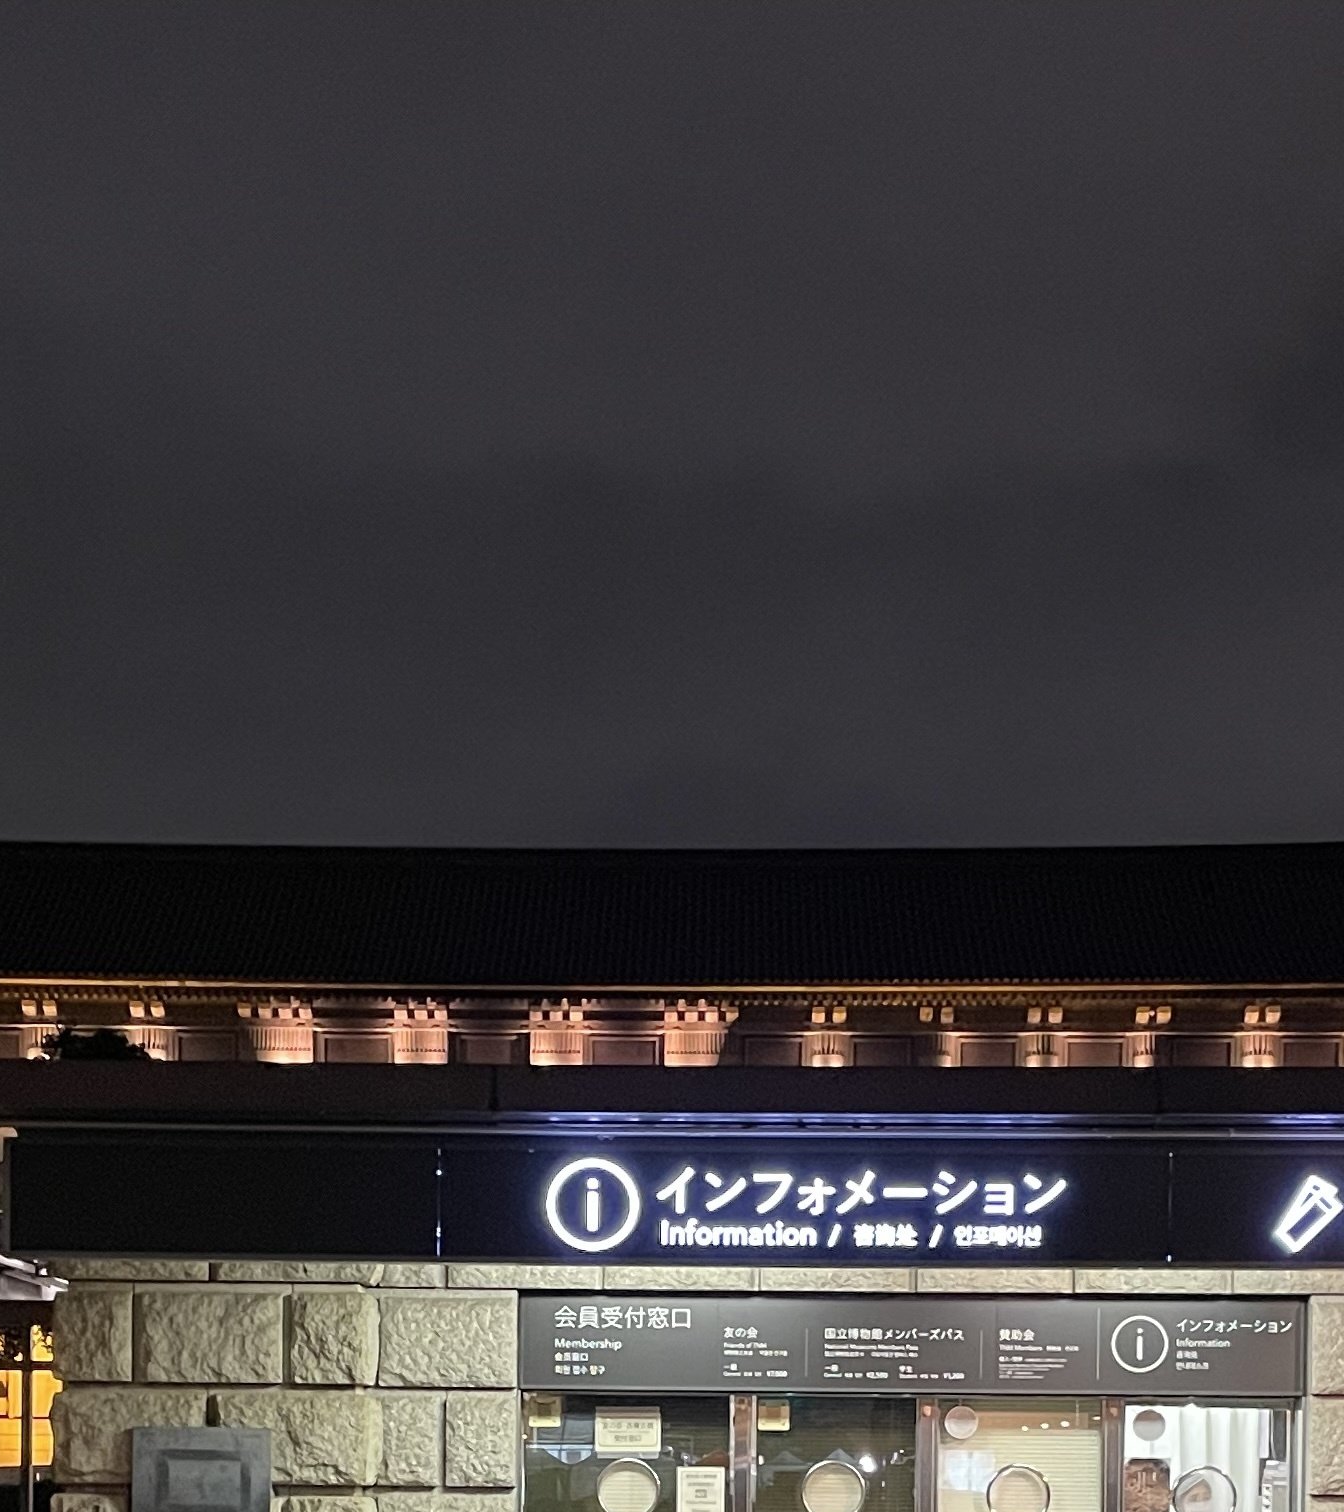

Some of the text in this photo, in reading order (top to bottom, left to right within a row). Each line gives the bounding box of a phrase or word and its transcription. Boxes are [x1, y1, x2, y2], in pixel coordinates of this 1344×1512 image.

[656, 1167, 1066, 1215] インフォメーション
[661, 1219, 817, 1246] Information
[555, 1305, 692, 1329] 会員受付窓口
[724, 1327, 758, 1338] 友の会
[1176, 1319, 1292, 1333] インフォメーション
[555, 1338, 622, 1351] Membership
[1176, 1338, 1230, 1347] Information
